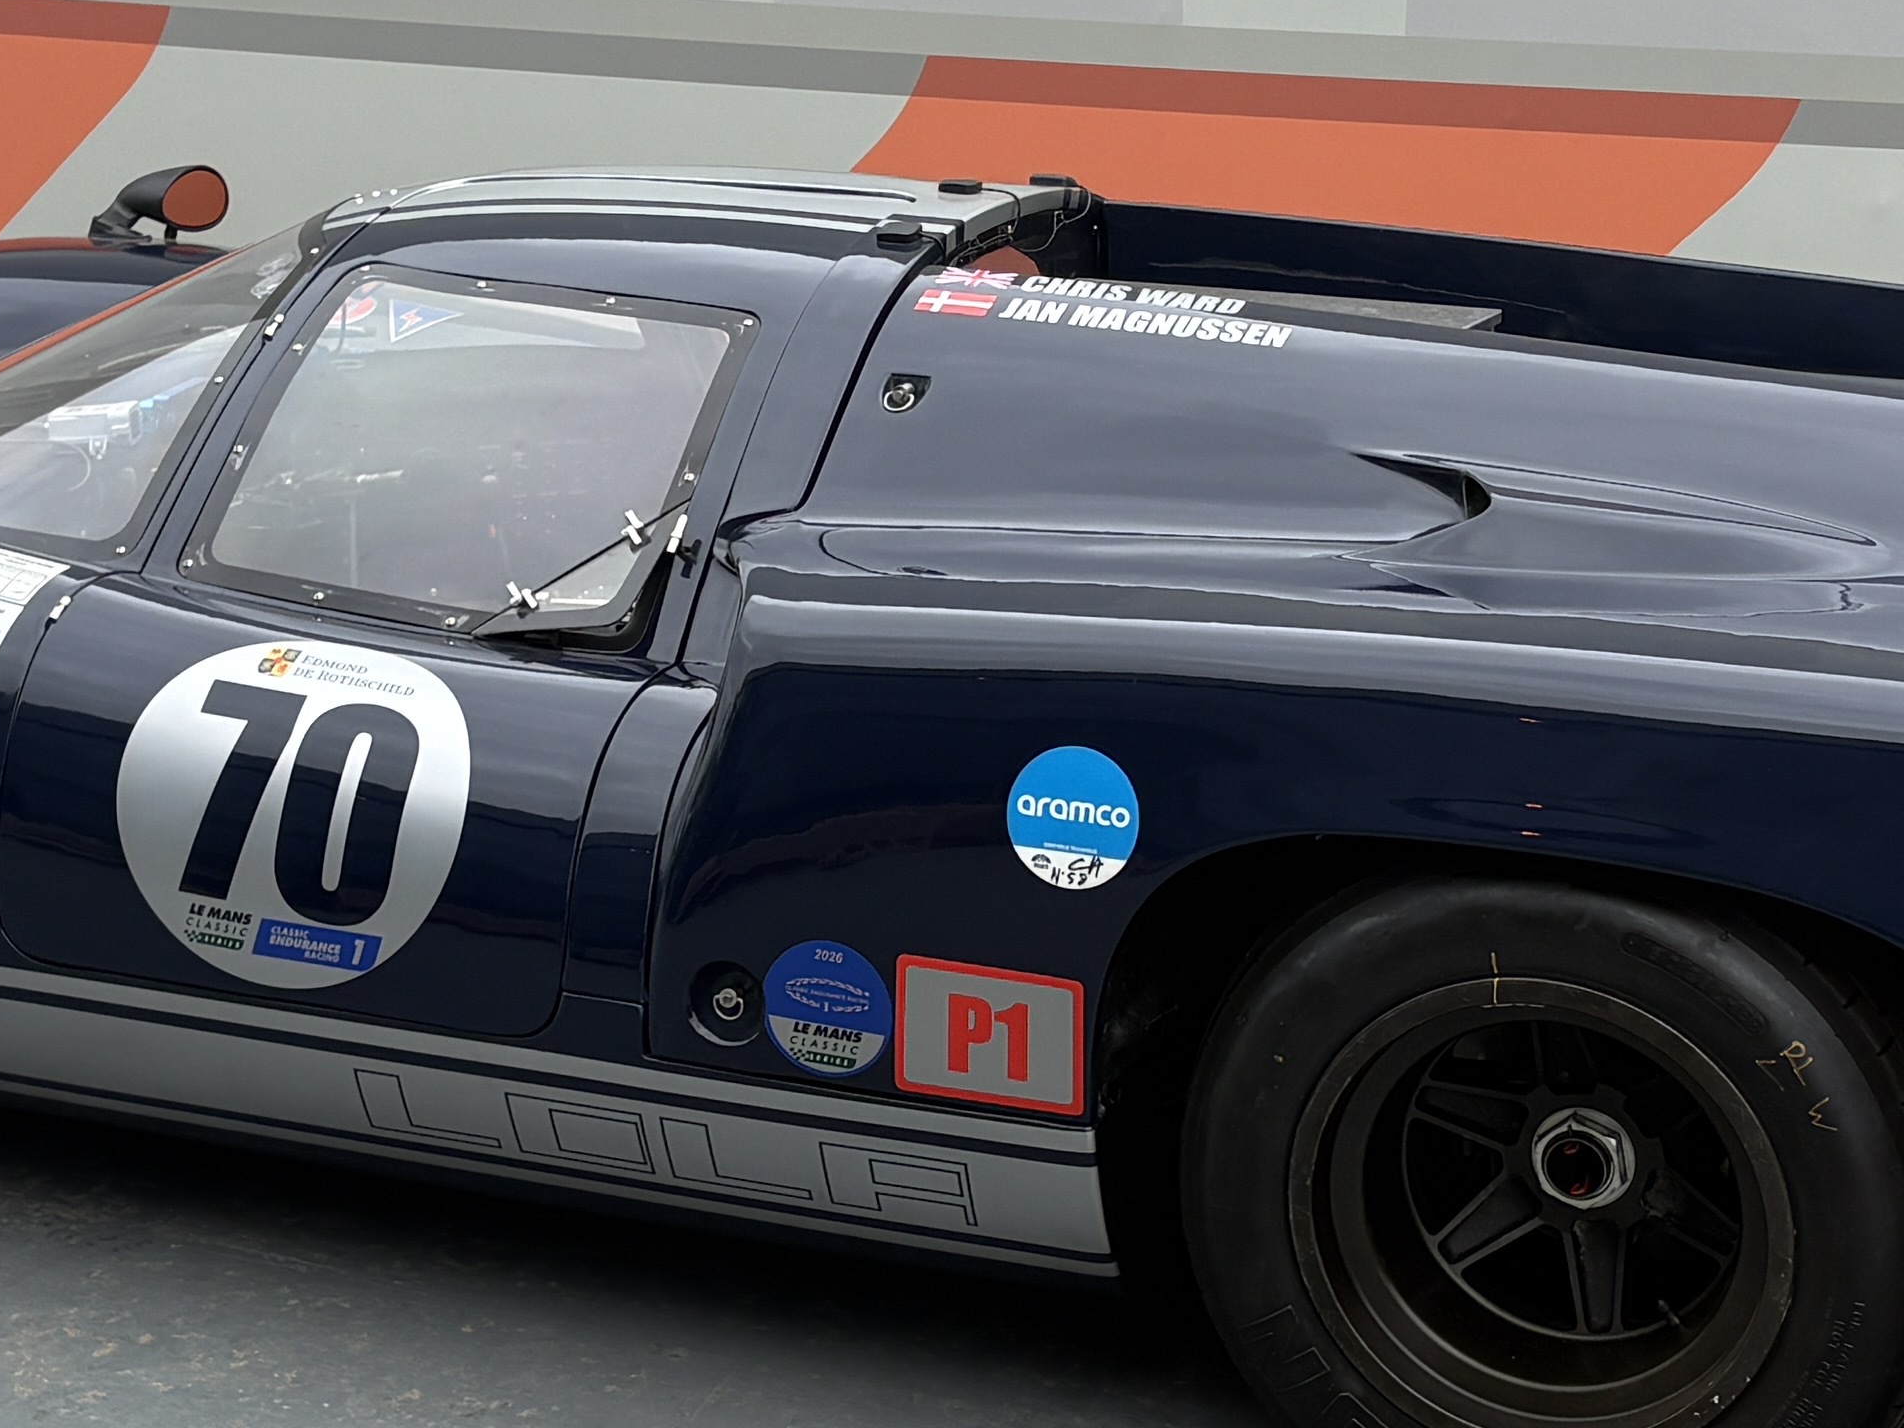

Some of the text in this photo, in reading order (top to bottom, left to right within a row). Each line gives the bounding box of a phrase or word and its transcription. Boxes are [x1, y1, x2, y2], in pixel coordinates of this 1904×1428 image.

[1020, 275, 1248, 315] CHRIS WARD
[998, 297, 1292, 349] JAN MAGNUSSEN
[176, 678, 420, 927] 70
[1016, 794, 1131, 829] aramco
[189, 902, 253, 925] LE MANS
[186, 916, 249, 937] CLASSIC
[270, 925, 310, 940] CLASSIC
[269, 935, 342, 954] ENDURANCE
[351, 939, 365, 965] 1
[814, 949, 844, 964] 2026
[792, 1021, 863, 1043] LE MANS
[946, 993, 1031, 1083] P1
[789, 1035, 860, 1055] CLASSIC
[353, 1068, 979, 1228] LOLA
